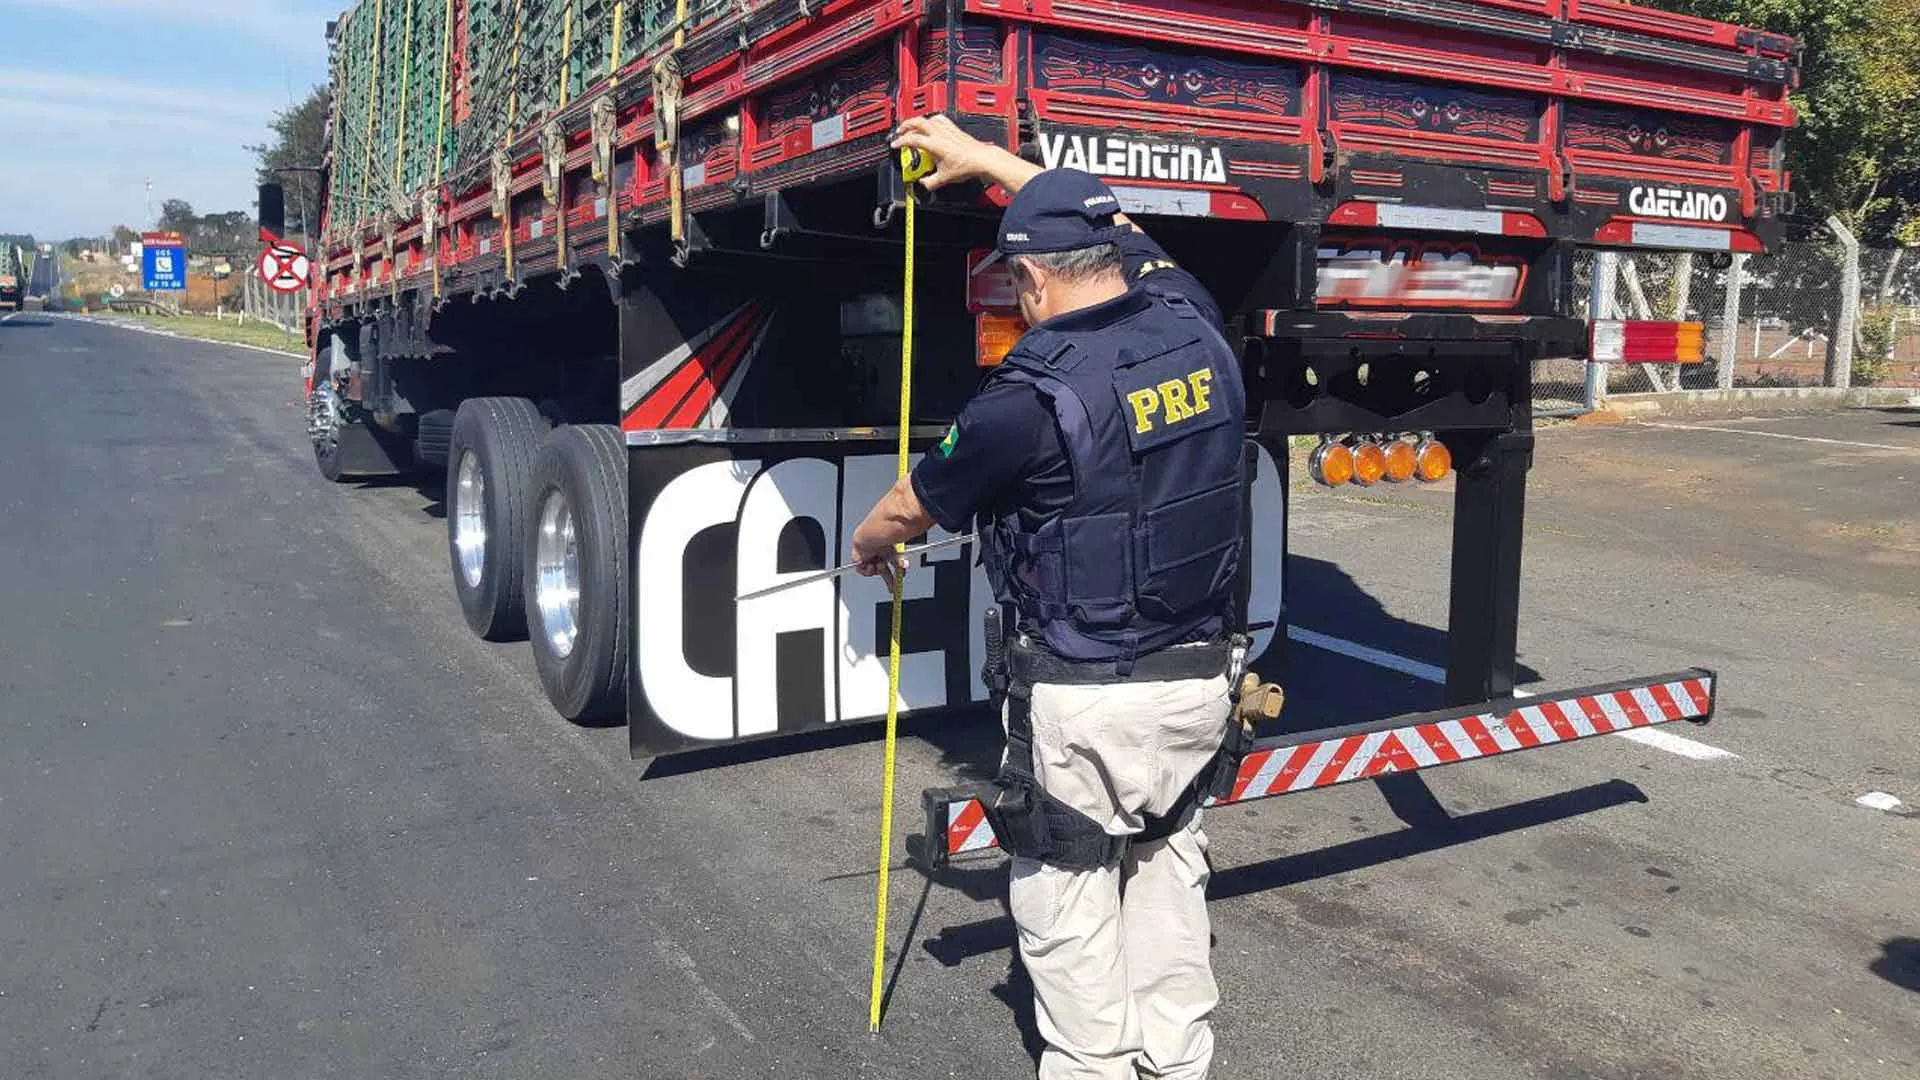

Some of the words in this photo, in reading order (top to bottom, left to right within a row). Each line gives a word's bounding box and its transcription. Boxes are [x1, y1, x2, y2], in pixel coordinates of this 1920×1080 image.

[1039, 133, 1226, 183] VALENTINA
[1628, 186, 1728, 222] CAETANO
[1127, 367, 1213, 434] PRF
